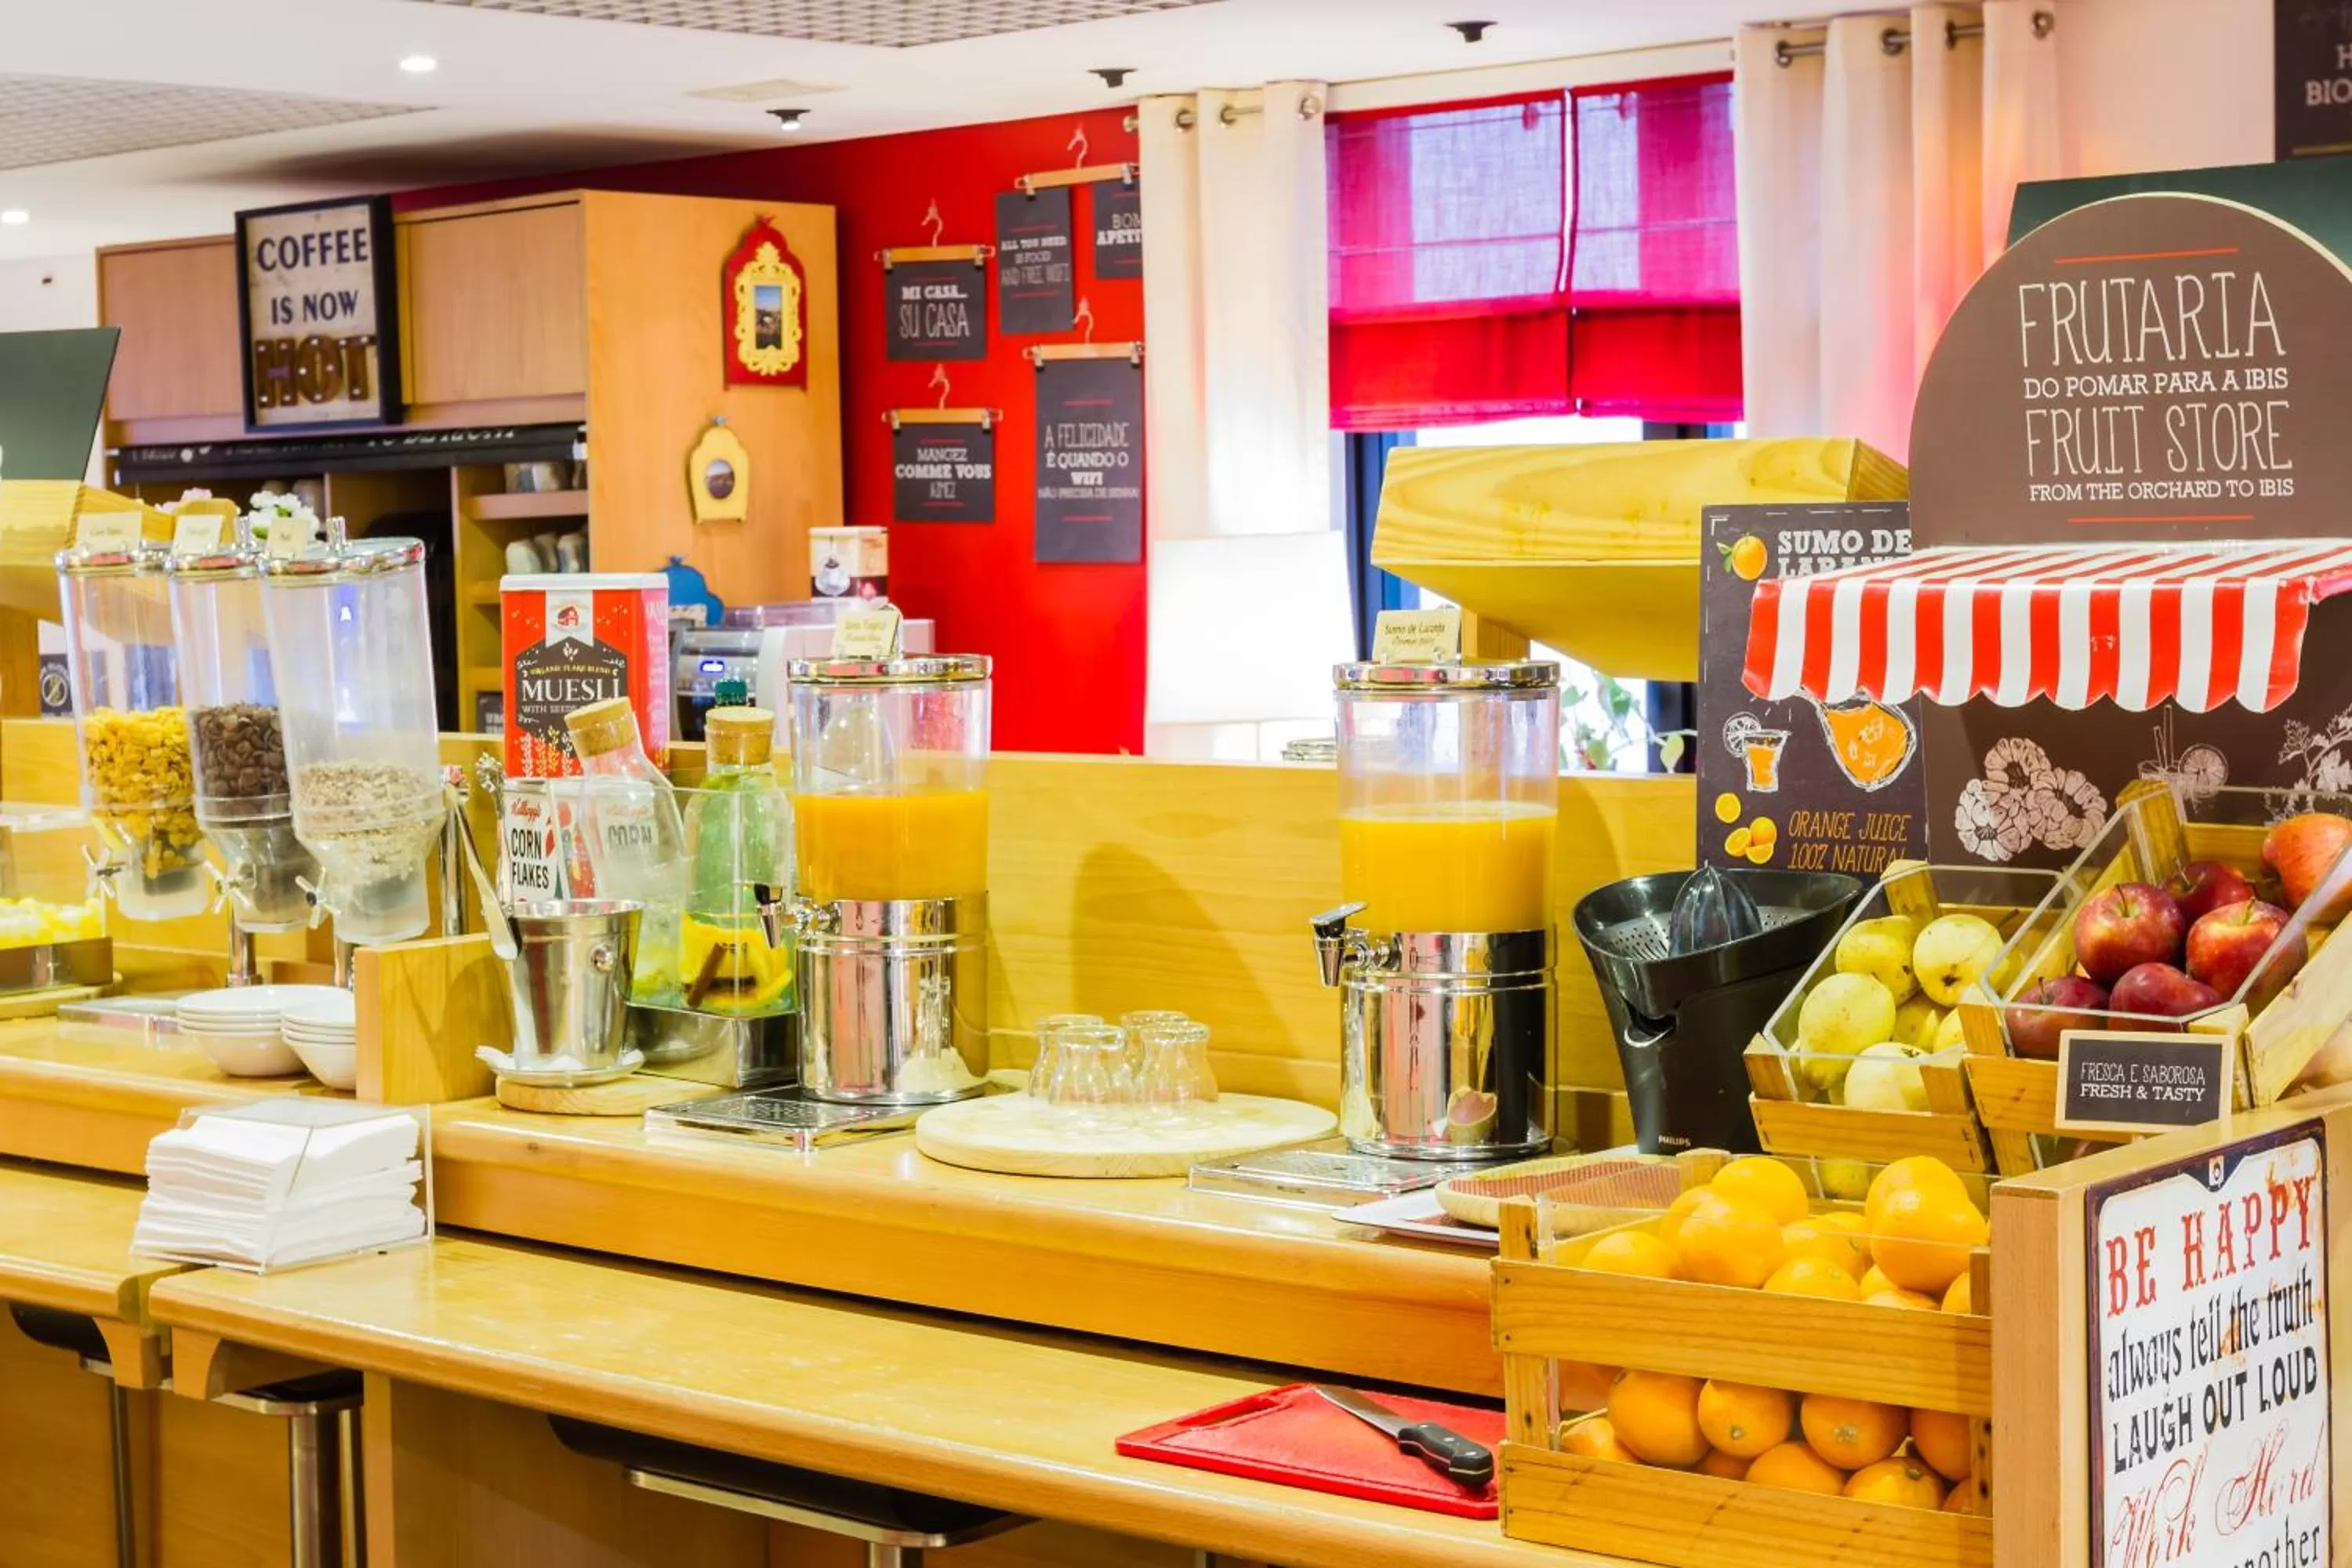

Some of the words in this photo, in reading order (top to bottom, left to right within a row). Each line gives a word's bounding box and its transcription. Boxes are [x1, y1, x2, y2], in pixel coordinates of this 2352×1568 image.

[256, 227, 368, 271] COFFEE
[1096, 229, 1142, 245] APETI
[1024, 250, 1052, 263] FOOD
[271, 295, 294, 325] IS
[303, 289, 359, 323] NOW
[902, 286, 921, 300] MI
[899, 303, 920, 339] SU
[926, 302, 971, 339] CASA
[2019, 271, 2286, 368] FRUTARIA
[255, 334, 377, 408] HOT
[2024, 376, 2060, 399] DO
[2066, 372, 2149, 397] POMAR
[2153, 371, 2216, 394] PARA
[2220, 372, 2240, 392] A
[2244, 367, 2289, 390] IBIS
[1044, 424, 1055, 448] A
[2025, 405, 2144, 477] FRUIT
[2166, 401, 2293, 475] STORE
[895, 463, 953, 479] COMME
[955, 463, 992, 479] VOUS
[1058, 451, 1116, 470] QUANDO
[1116, 451, 1130, 468] O
[2029, 482, 2083, 503] FROM
[2085, 482, 2124, 501] THE
[2128, 481, 2222, 500] ORCHARD
[2225, 481, 2256, 498] TO
[2259, 478, 2295, 497] IBIS
[1777, 529, 1864, 555] SUMO
[1870, 529, 1913, 555] DE
[521, 677, 619, 702] MUESLI
[521, 704, 547, 714] WITH
[1788, 810, 1857, 840] ORANGE
[1859, 812, 1913, 841] JUICE
[510, 827, 543, 861] CORN
[511, 861, 550, 890] FLAKES
[2080, 1062, 2126, 1083] FRESCA
[2129, 1063, 2139, 1083] E
[2142, 1064, 2206, 1086] SABOROSA
[2079, 1083, 2132, 1099] FRESH
[2136, 1085, 2148, 1100] &
[2152, 1085, 2206, 1102] TASTY
[1658, 1134, 1692, 1148] PHILIPS
[2105, 1225, 2158, 1319] BE
[2180, 1176, 2313, 1292] HAPPY
[2108, 1327, 2182, 1403] always
[2190, 1303, 2223, 1370] tell
[2229, 1284, 2261, 1355] the
[2267, 1260, 2314, 1341] truth
[2113, 1391, 2194, 1475] LAUGH
[2202, 1371, 2249, 1436] OUT
[2258, 1345, 2318, 1414] LOUD
[2234, 1514, 2320, 1568] ther
